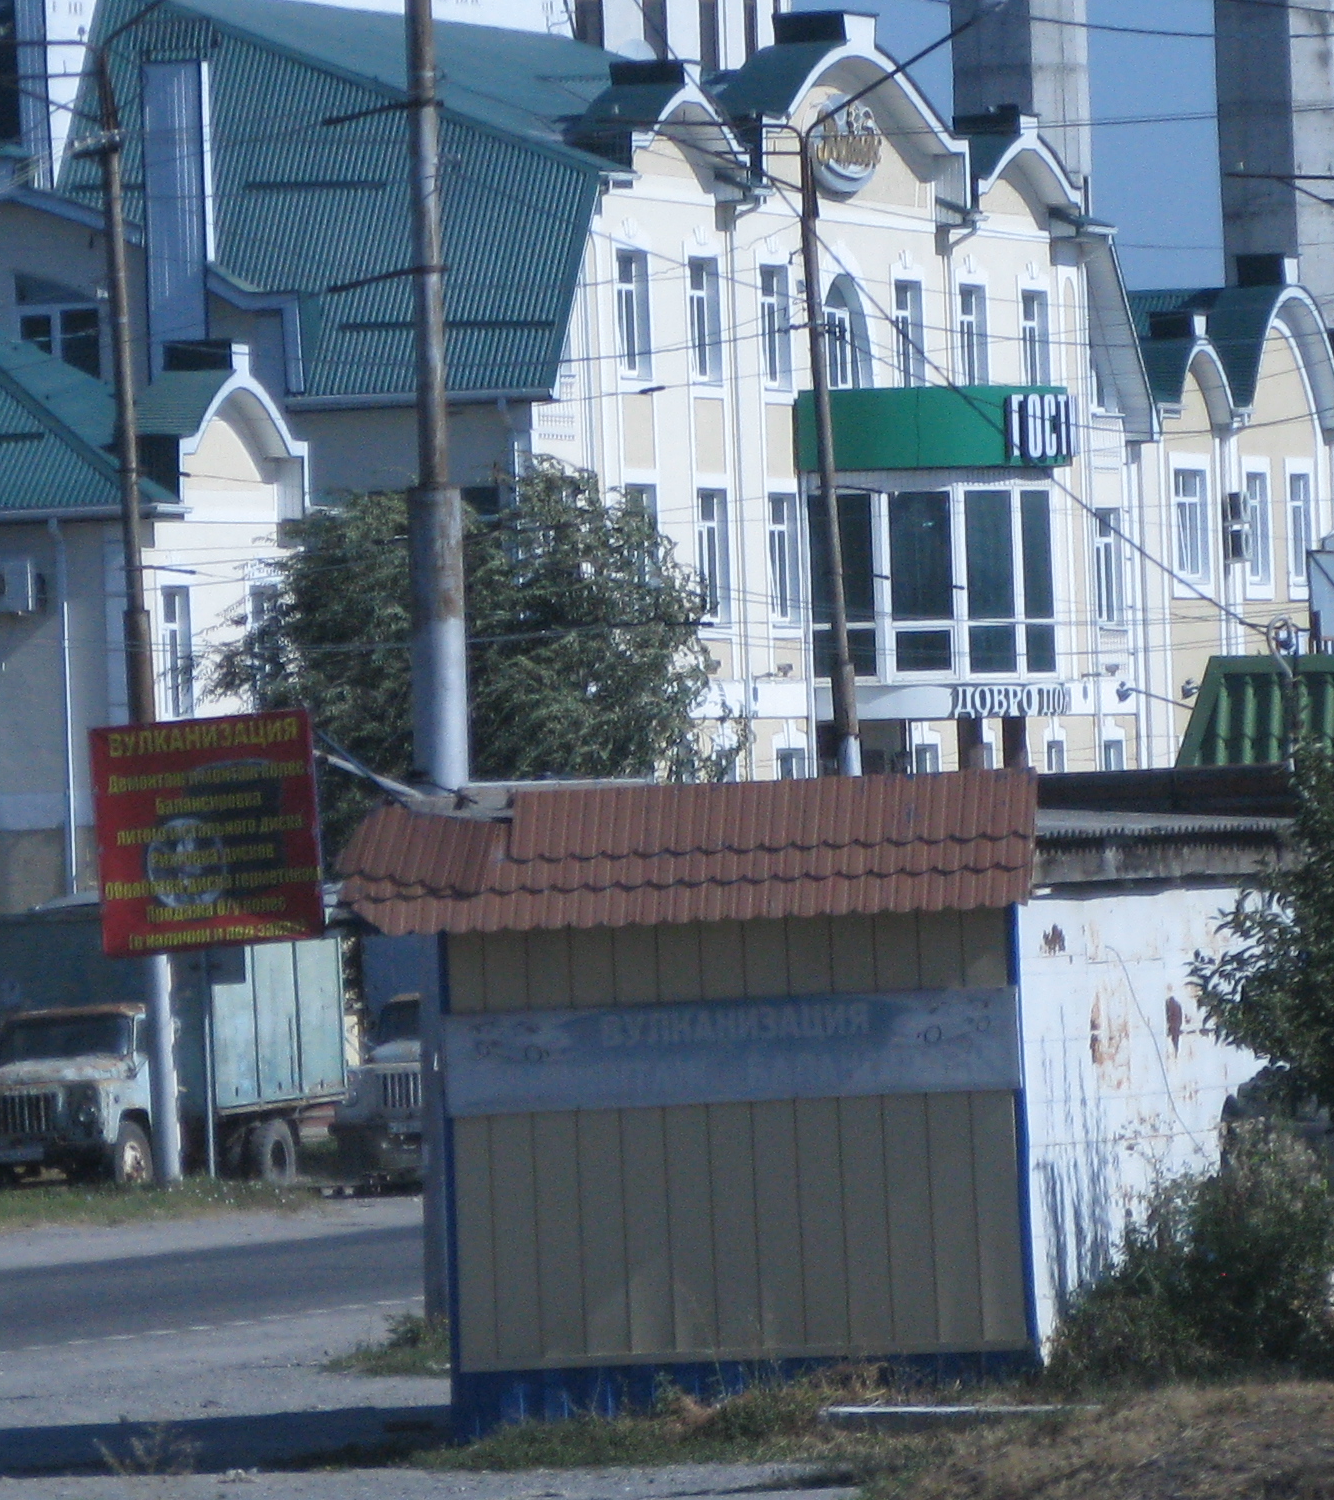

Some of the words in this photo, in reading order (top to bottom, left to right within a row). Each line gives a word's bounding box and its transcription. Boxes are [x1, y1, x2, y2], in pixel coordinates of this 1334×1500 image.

[109, 717, 297, 758] ВУЛКАНИЗАЦИЯ
[156, 790, 262, 816] Балансировка
[148, 901, 213, 922] Продажа
[601, 1002, 869, 1046] ВУЛКАНИЗАЦИЯ
